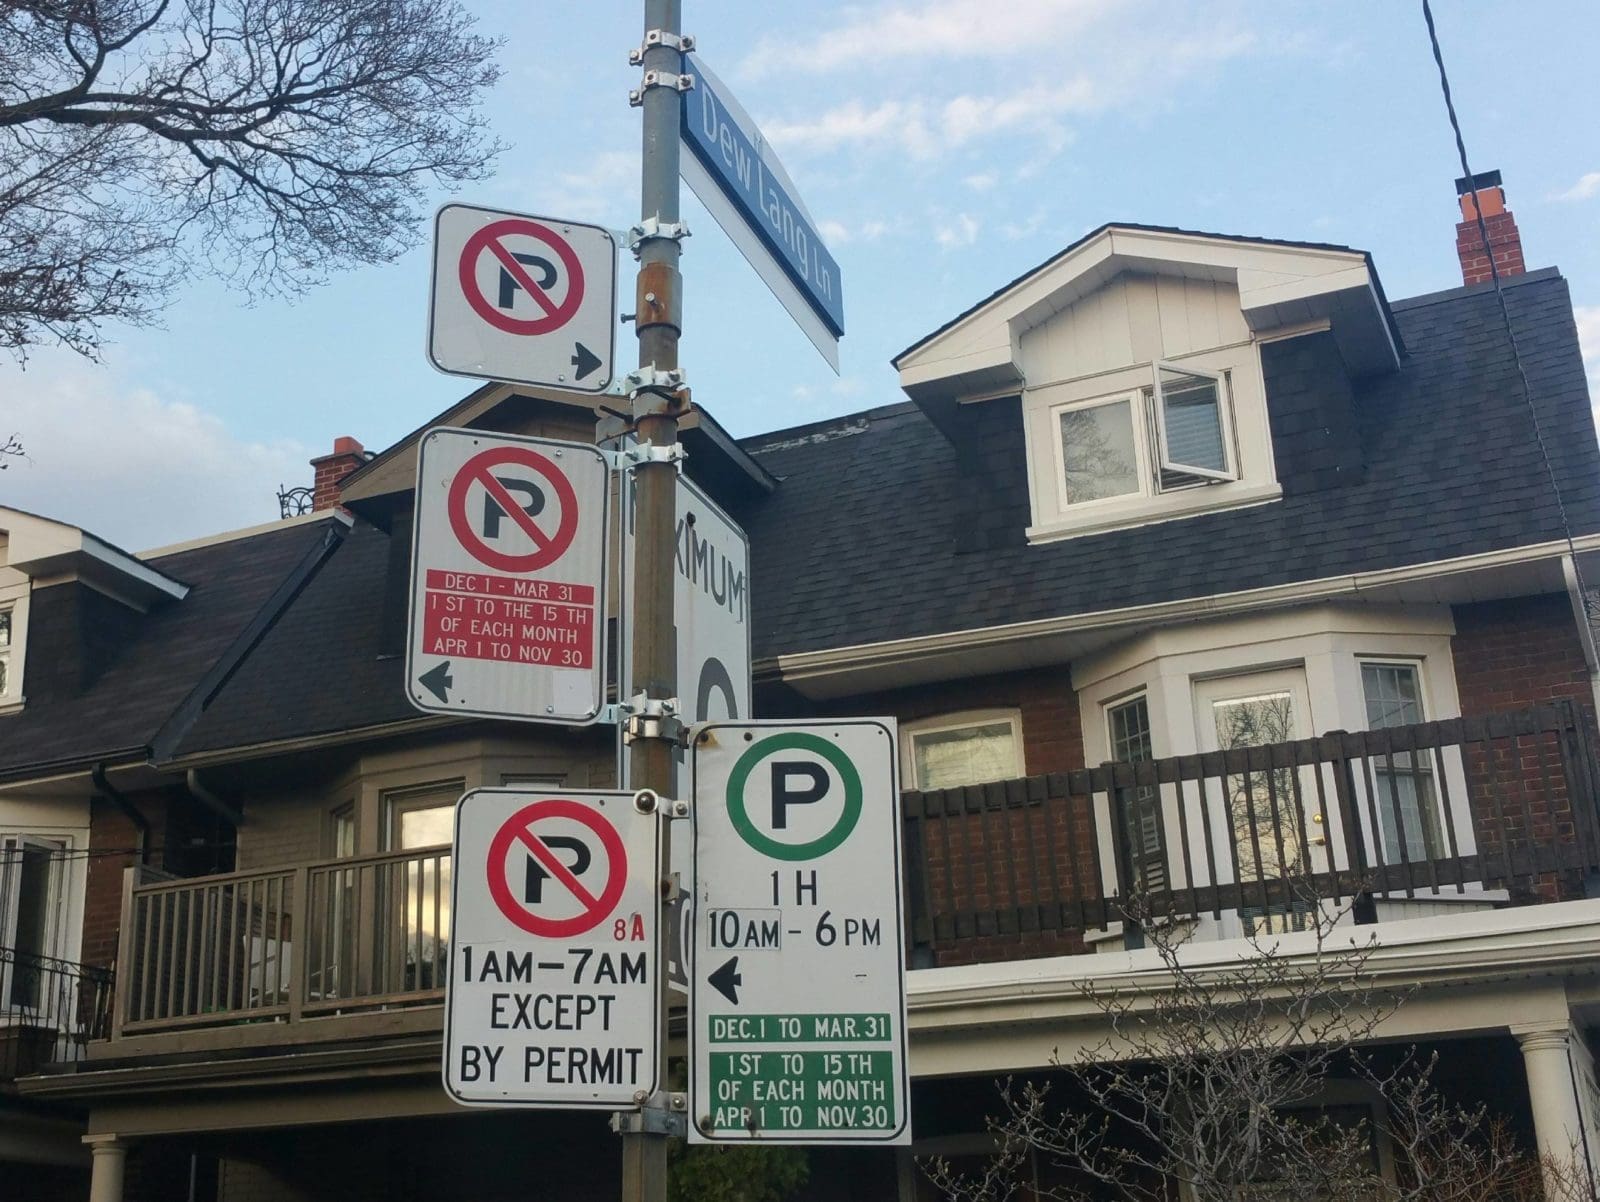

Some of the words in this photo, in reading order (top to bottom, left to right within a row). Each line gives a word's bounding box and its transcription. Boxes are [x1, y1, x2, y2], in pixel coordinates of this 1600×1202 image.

[701, 82, 750, 191] Dew
[758, 160, 809, 280] Lang
[815, 247, 832, 301] Ln
[445, 574, 476, 591] DEC
[485, 578, 490, 593] 1
[513, 580, 549, 599] MAR
[558, 585, 573, 601] 31
[475, 599, 495, 615] TO
[504, 602, 534, 619] THE
[441, 617, 462, 633] OF
[471, 620, 514, 638] EACH
[522, 625, 577, 644] MONTH
[434, 638, 467, 655] APR
[477, 642, 482, 656] 1
[491, 642, 511, 659] TO
[519, 645, 552, 662] NOV
[561, 650, 583, 665] 30
[771, 761, 830, 829] P
[709, 910, 779, 948] 10AM
[490, 993, 616, 1031] EXCEPT
[778, 1017, 801, 1039] TO
[460, 1045, 505, 1083] BY
[524, 1046, 643, 1085] PERMIT
[729, 1054, 762, 1076] 1ST
[781, 1054, 804, 1075] TO
[718, 1079, 742, 1101] OF
[752, 1079, 804, 1101] EACH
[817, 1079, 885, 1101] MONTH
[780, 1106, 803, 1127] TO
